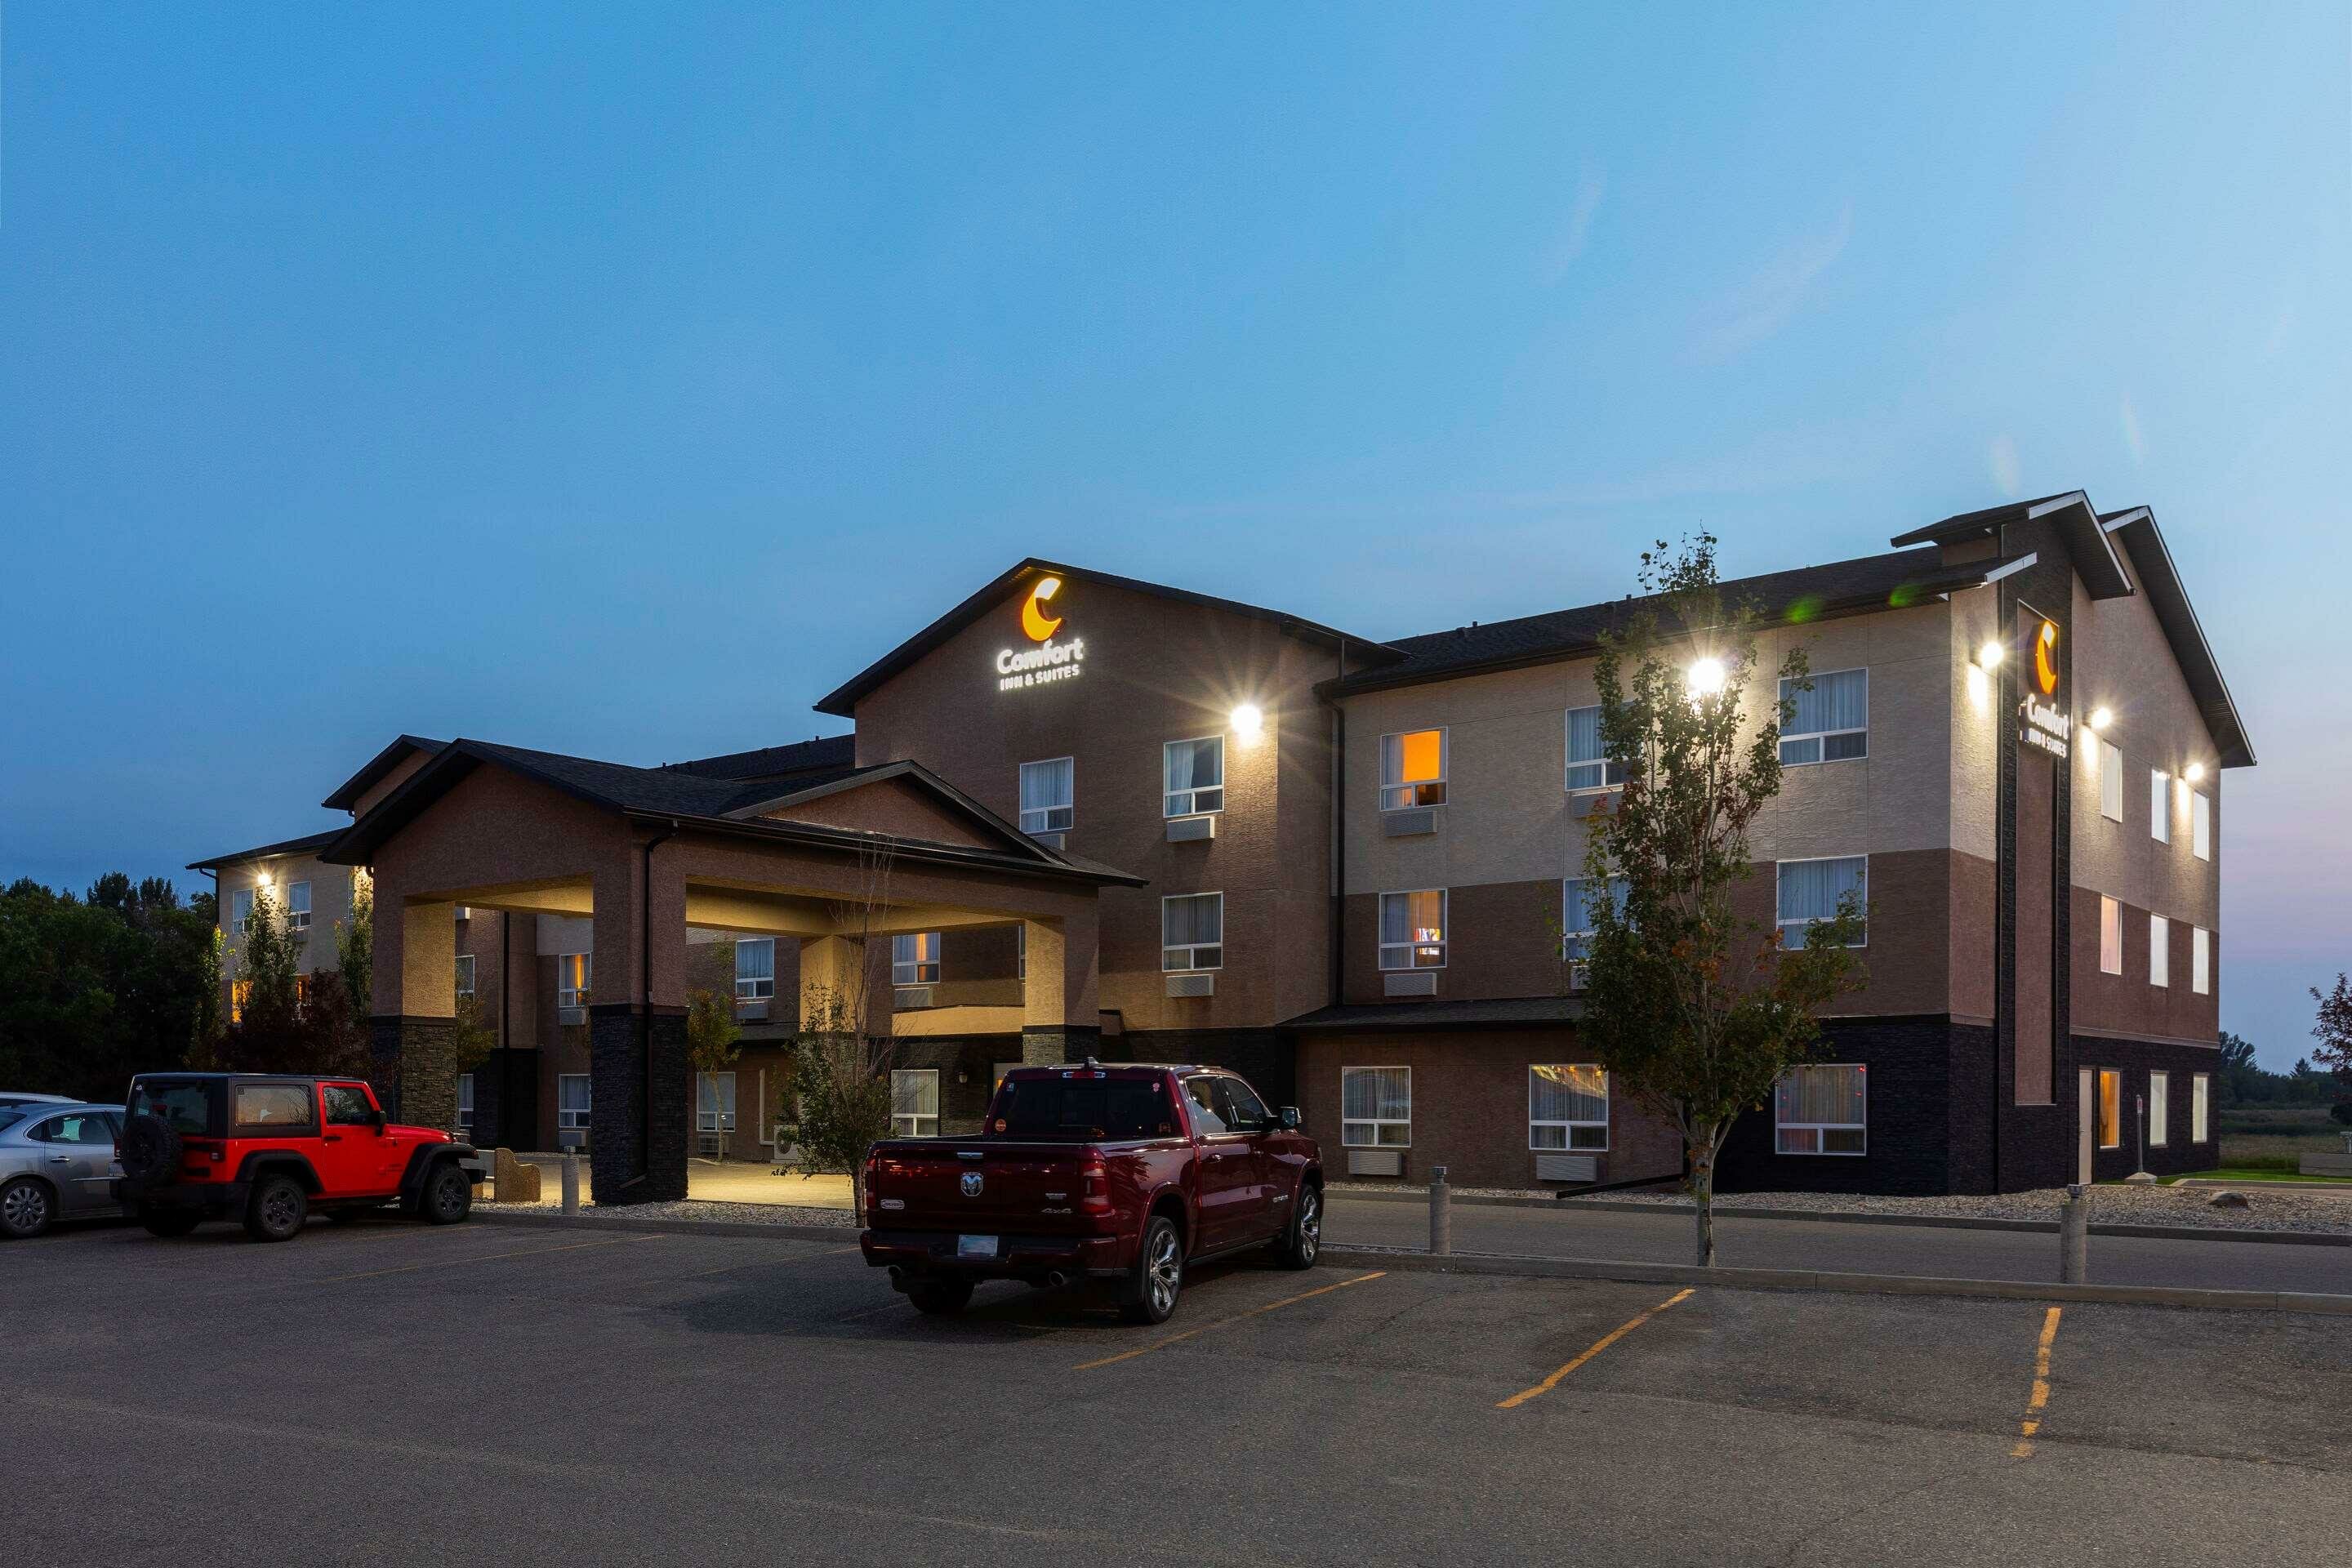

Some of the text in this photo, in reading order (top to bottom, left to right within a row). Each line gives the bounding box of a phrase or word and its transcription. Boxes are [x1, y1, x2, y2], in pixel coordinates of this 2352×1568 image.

[996, 638, 1084, 674] Comfort
[1000, 664, 1080, 691] INN & SUITES
